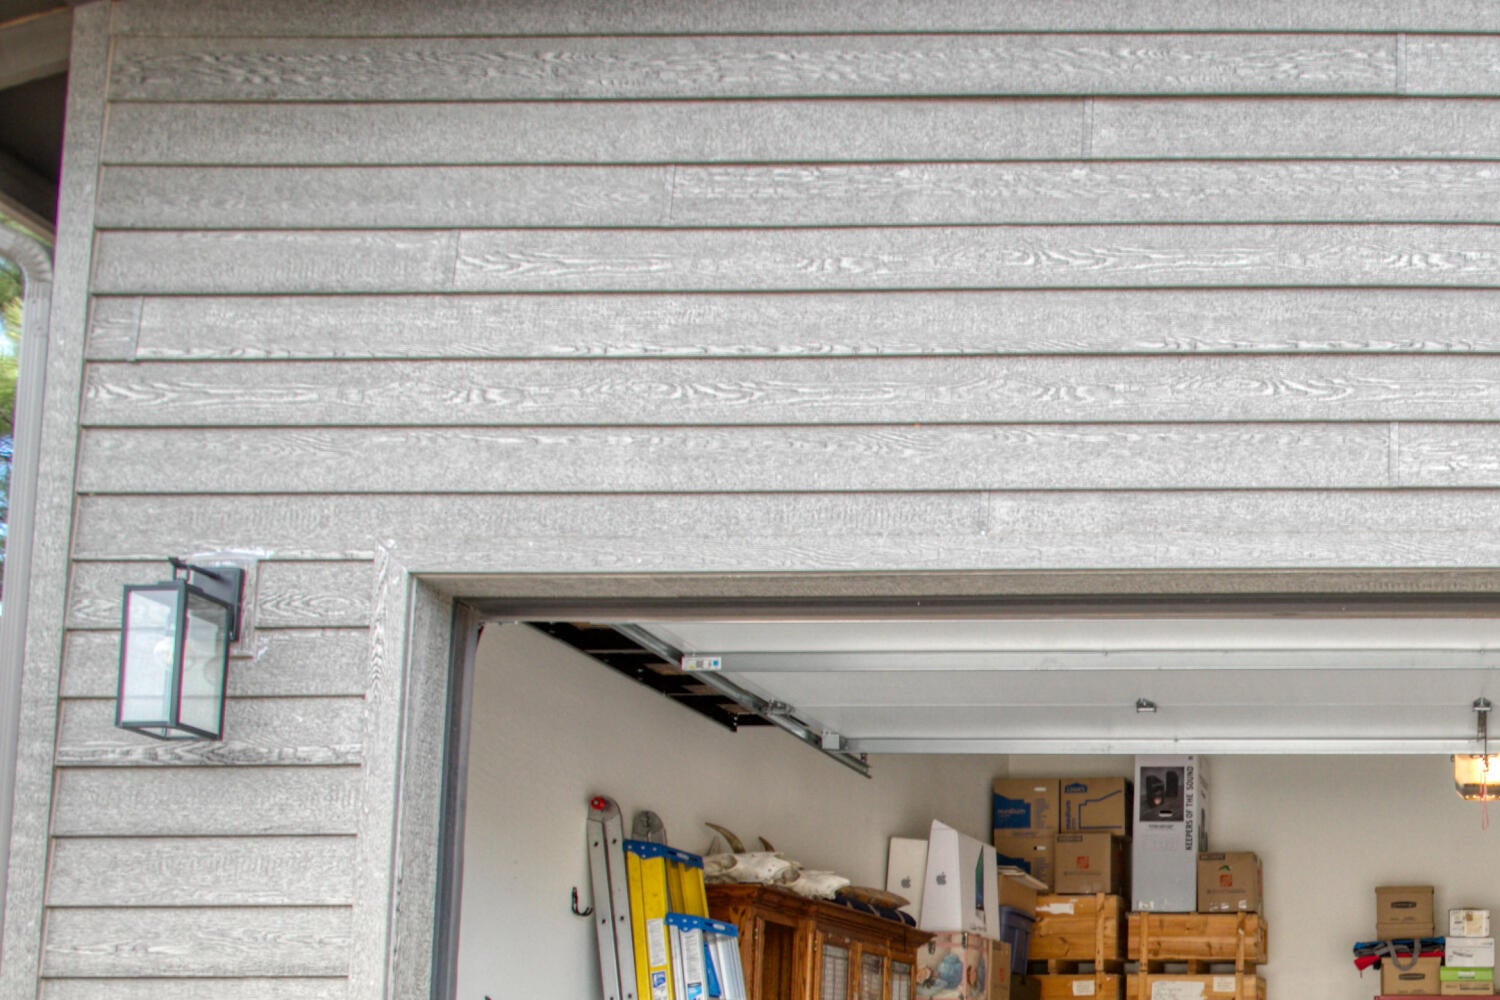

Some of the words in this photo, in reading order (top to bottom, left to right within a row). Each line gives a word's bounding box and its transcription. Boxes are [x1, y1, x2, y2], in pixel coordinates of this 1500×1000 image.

[1186, 766, 1194, 791] SOUND
[1185, 794, 1194, 807] THE
[1184, 820, 1193, 851] KEEPERS
